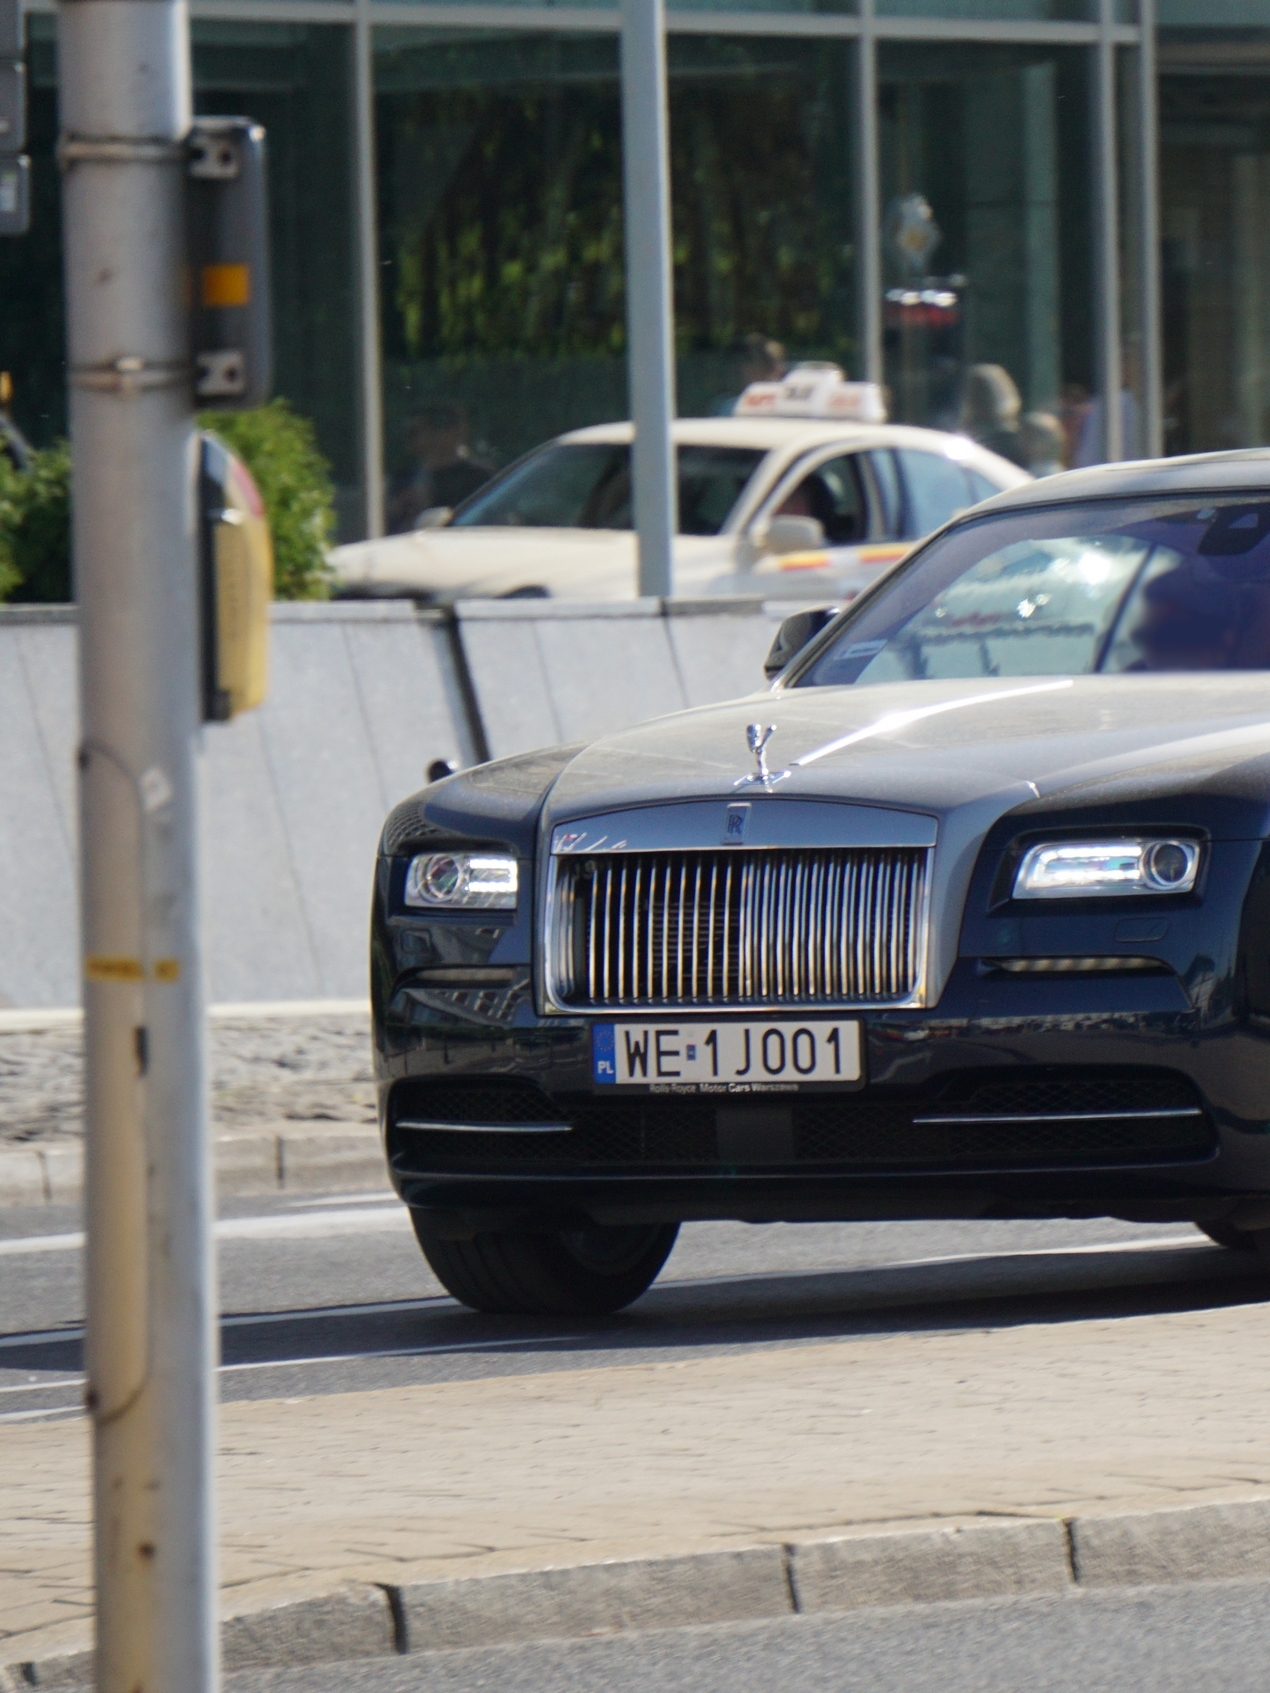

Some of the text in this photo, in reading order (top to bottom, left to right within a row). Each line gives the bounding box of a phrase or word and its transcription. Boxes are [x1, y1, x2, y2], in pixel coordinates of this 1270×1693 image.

[624, 1027, 841, 1078] WE 1J001
[597, 1060, 615, 1075] PL
[649, 1081, 799, 1095] Rolls-Royce Motor Cars Warszawa
